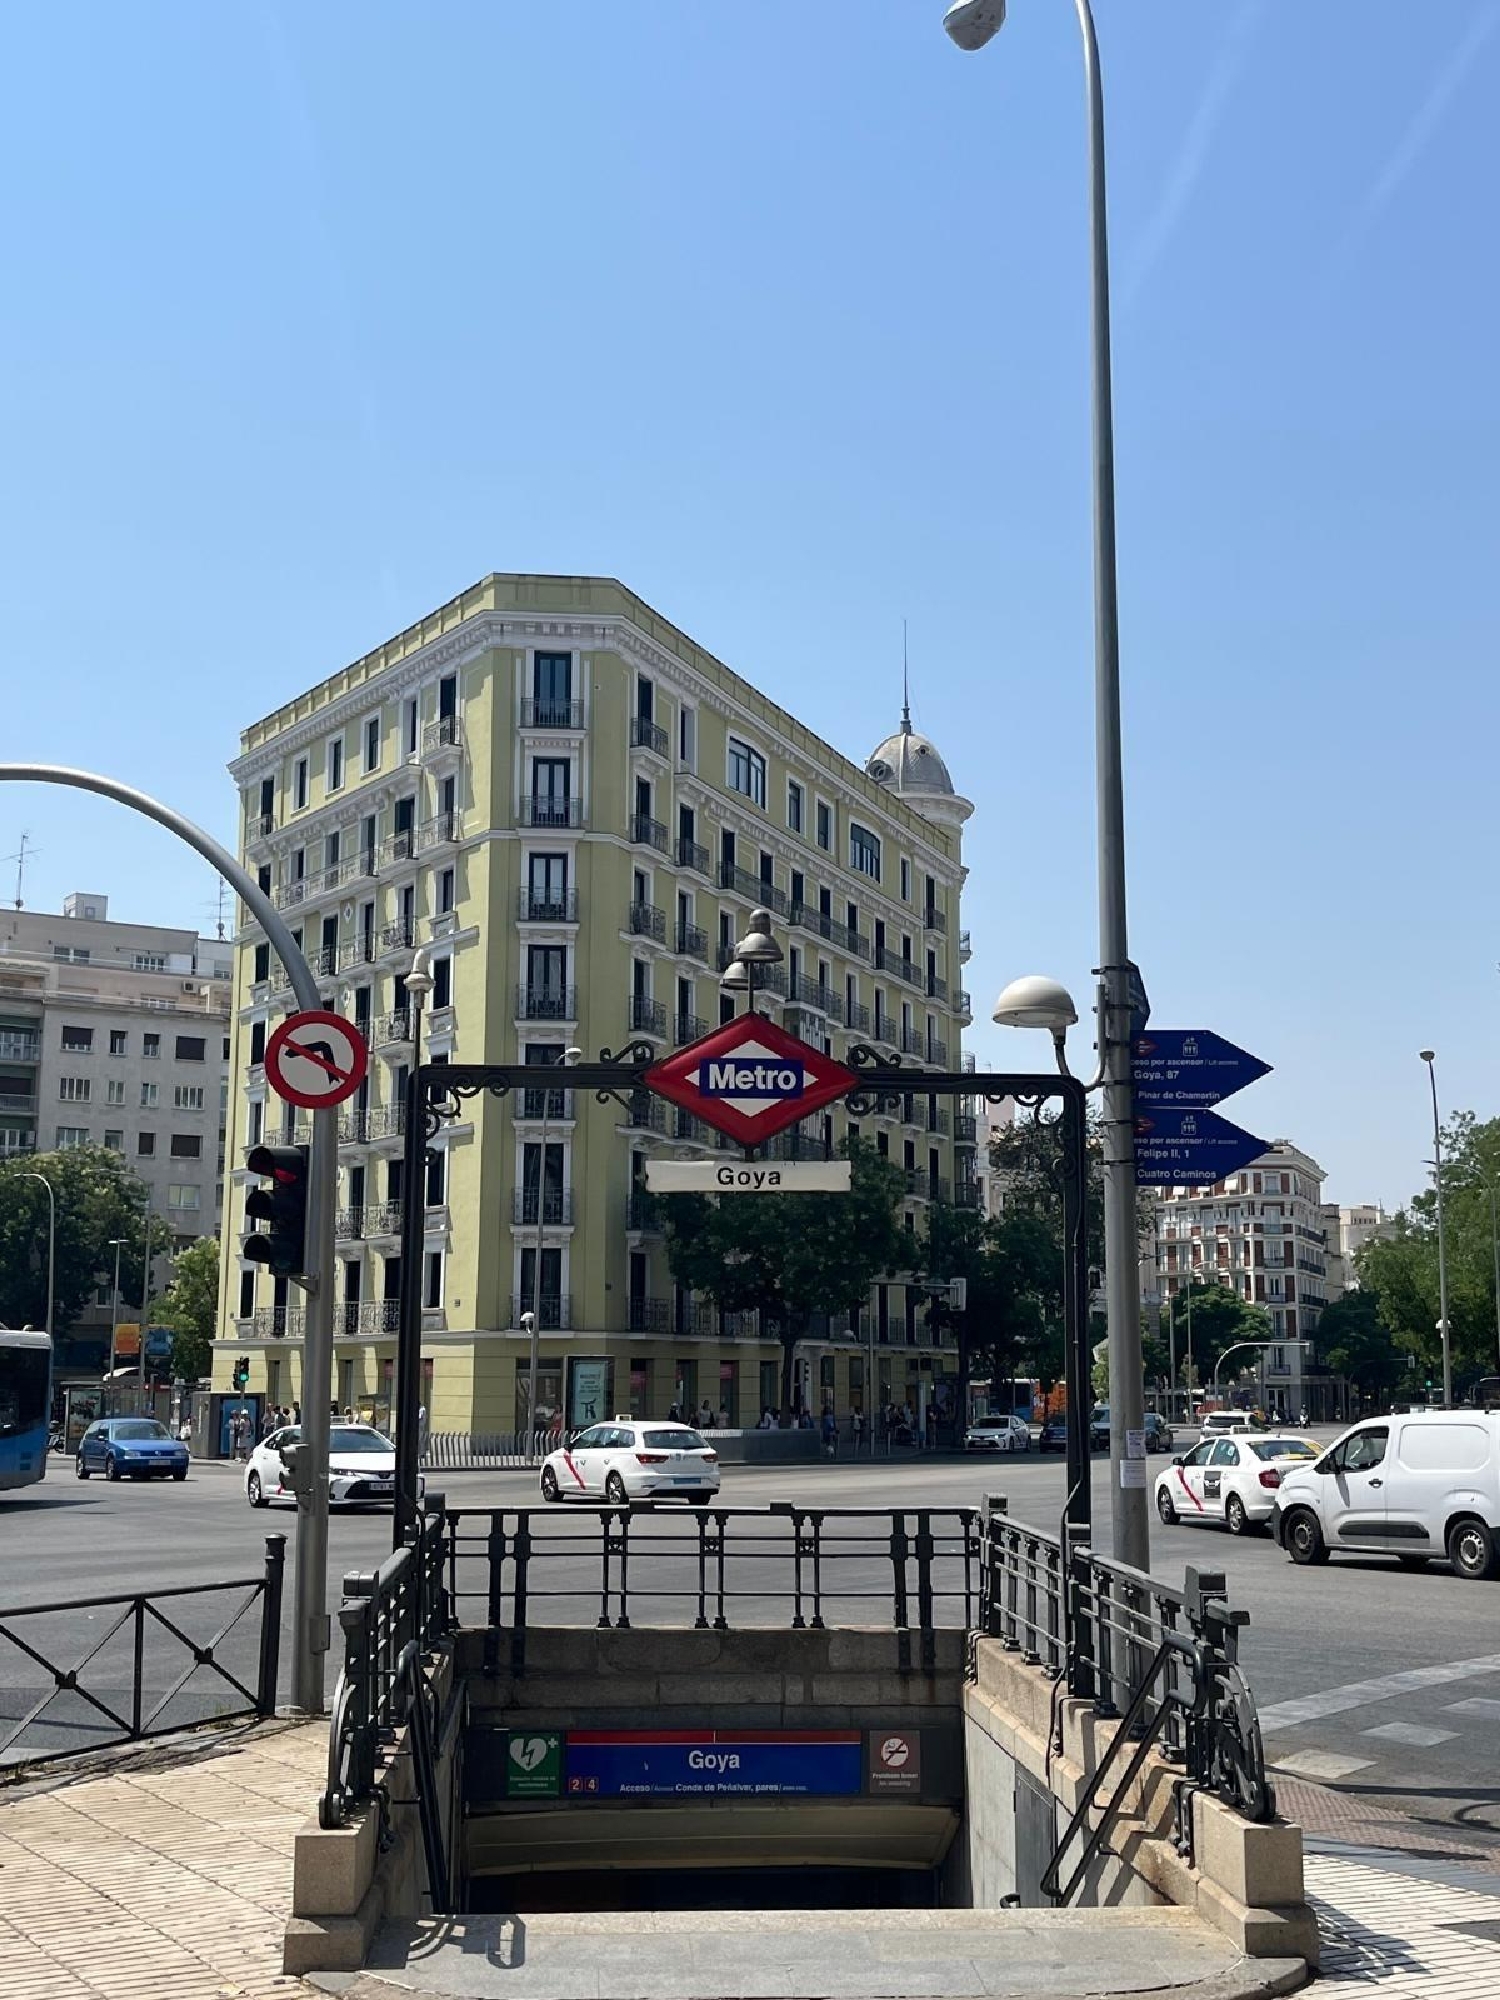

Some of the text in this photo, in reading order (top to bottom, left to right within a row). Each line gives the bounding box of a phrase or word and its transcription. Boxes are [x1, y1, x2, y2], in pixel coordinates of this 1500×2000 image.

[1151, 1059, 1164, 1067] por
[709, 1064, 796, 1090] Metro
[1134, 1069, 1180, 1081] Goya, 87
[1138, 1090, 1160, 1099] Pinar
[1163, 1090, 1174, 1099] de
[1137, 1149, 1168, 1160] Felipe
[1184, 1150, 1189, 1158] 1
[717, 1167, 781, 1189] Goya
[1137, 1169, 1217, 1179] Cuatro Caminos
[688, 1750, 740, 1774] Goya
[573, 1779, 595, 1790] 2 4
[675, 1783, 702, 1791] Conde
[704, 1783, 715, 1791] de
